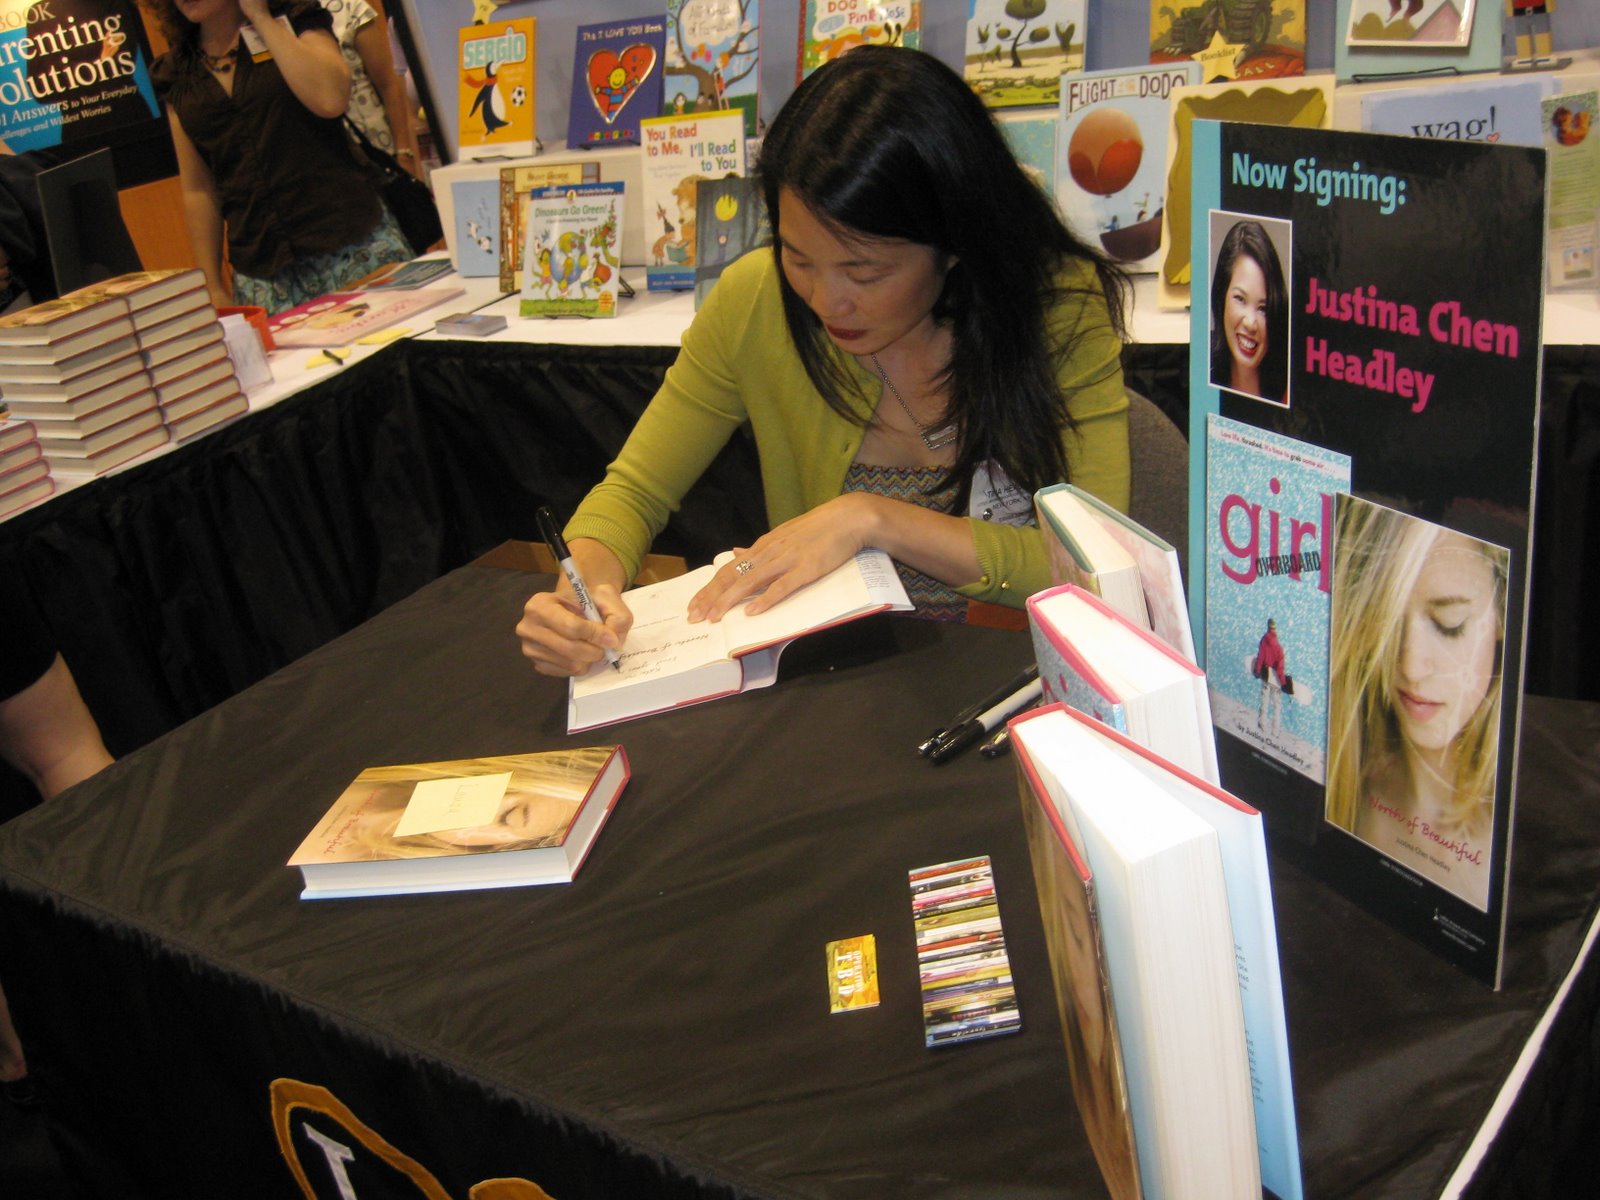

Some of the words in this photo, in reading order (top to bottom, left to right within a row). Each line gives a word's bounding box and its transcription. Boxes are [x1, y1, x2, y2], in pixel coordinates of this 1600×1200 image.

[848, 8, 876, 24] Pink
[0, 14, 126, 67] renting
[1201, 48, 1236, 61] Booklist
[11, 100, 69, 124] Answers
[81, 95, 100, 105] Your
[101, 85, 137, 100] Everyday
[646, 128, 666, 141] You
[670, 123, 697, 139] Read
[647, 144, 658, 157] to
[708, 139, 736, 156] Read
[701, 160, 713, 172] to
[715, 156, 737, 170] You
[1232, 152, 1288, 190] Now
[1293, 157, 1407, 215] Signing:
[570, 204, 581, 215] Go
[1305, 277, 1420, 337] Justina
[1428, 300, 1519, 359] Chen
[1306, 336, 1436, 414] Headley
[1219, 477, 1332, 593] girl
[1255, 551, 1321, 578] OVERBOARD
[1407, 816, 1419, 835] of
[1421, 822, 1482, 866] Beautiful
